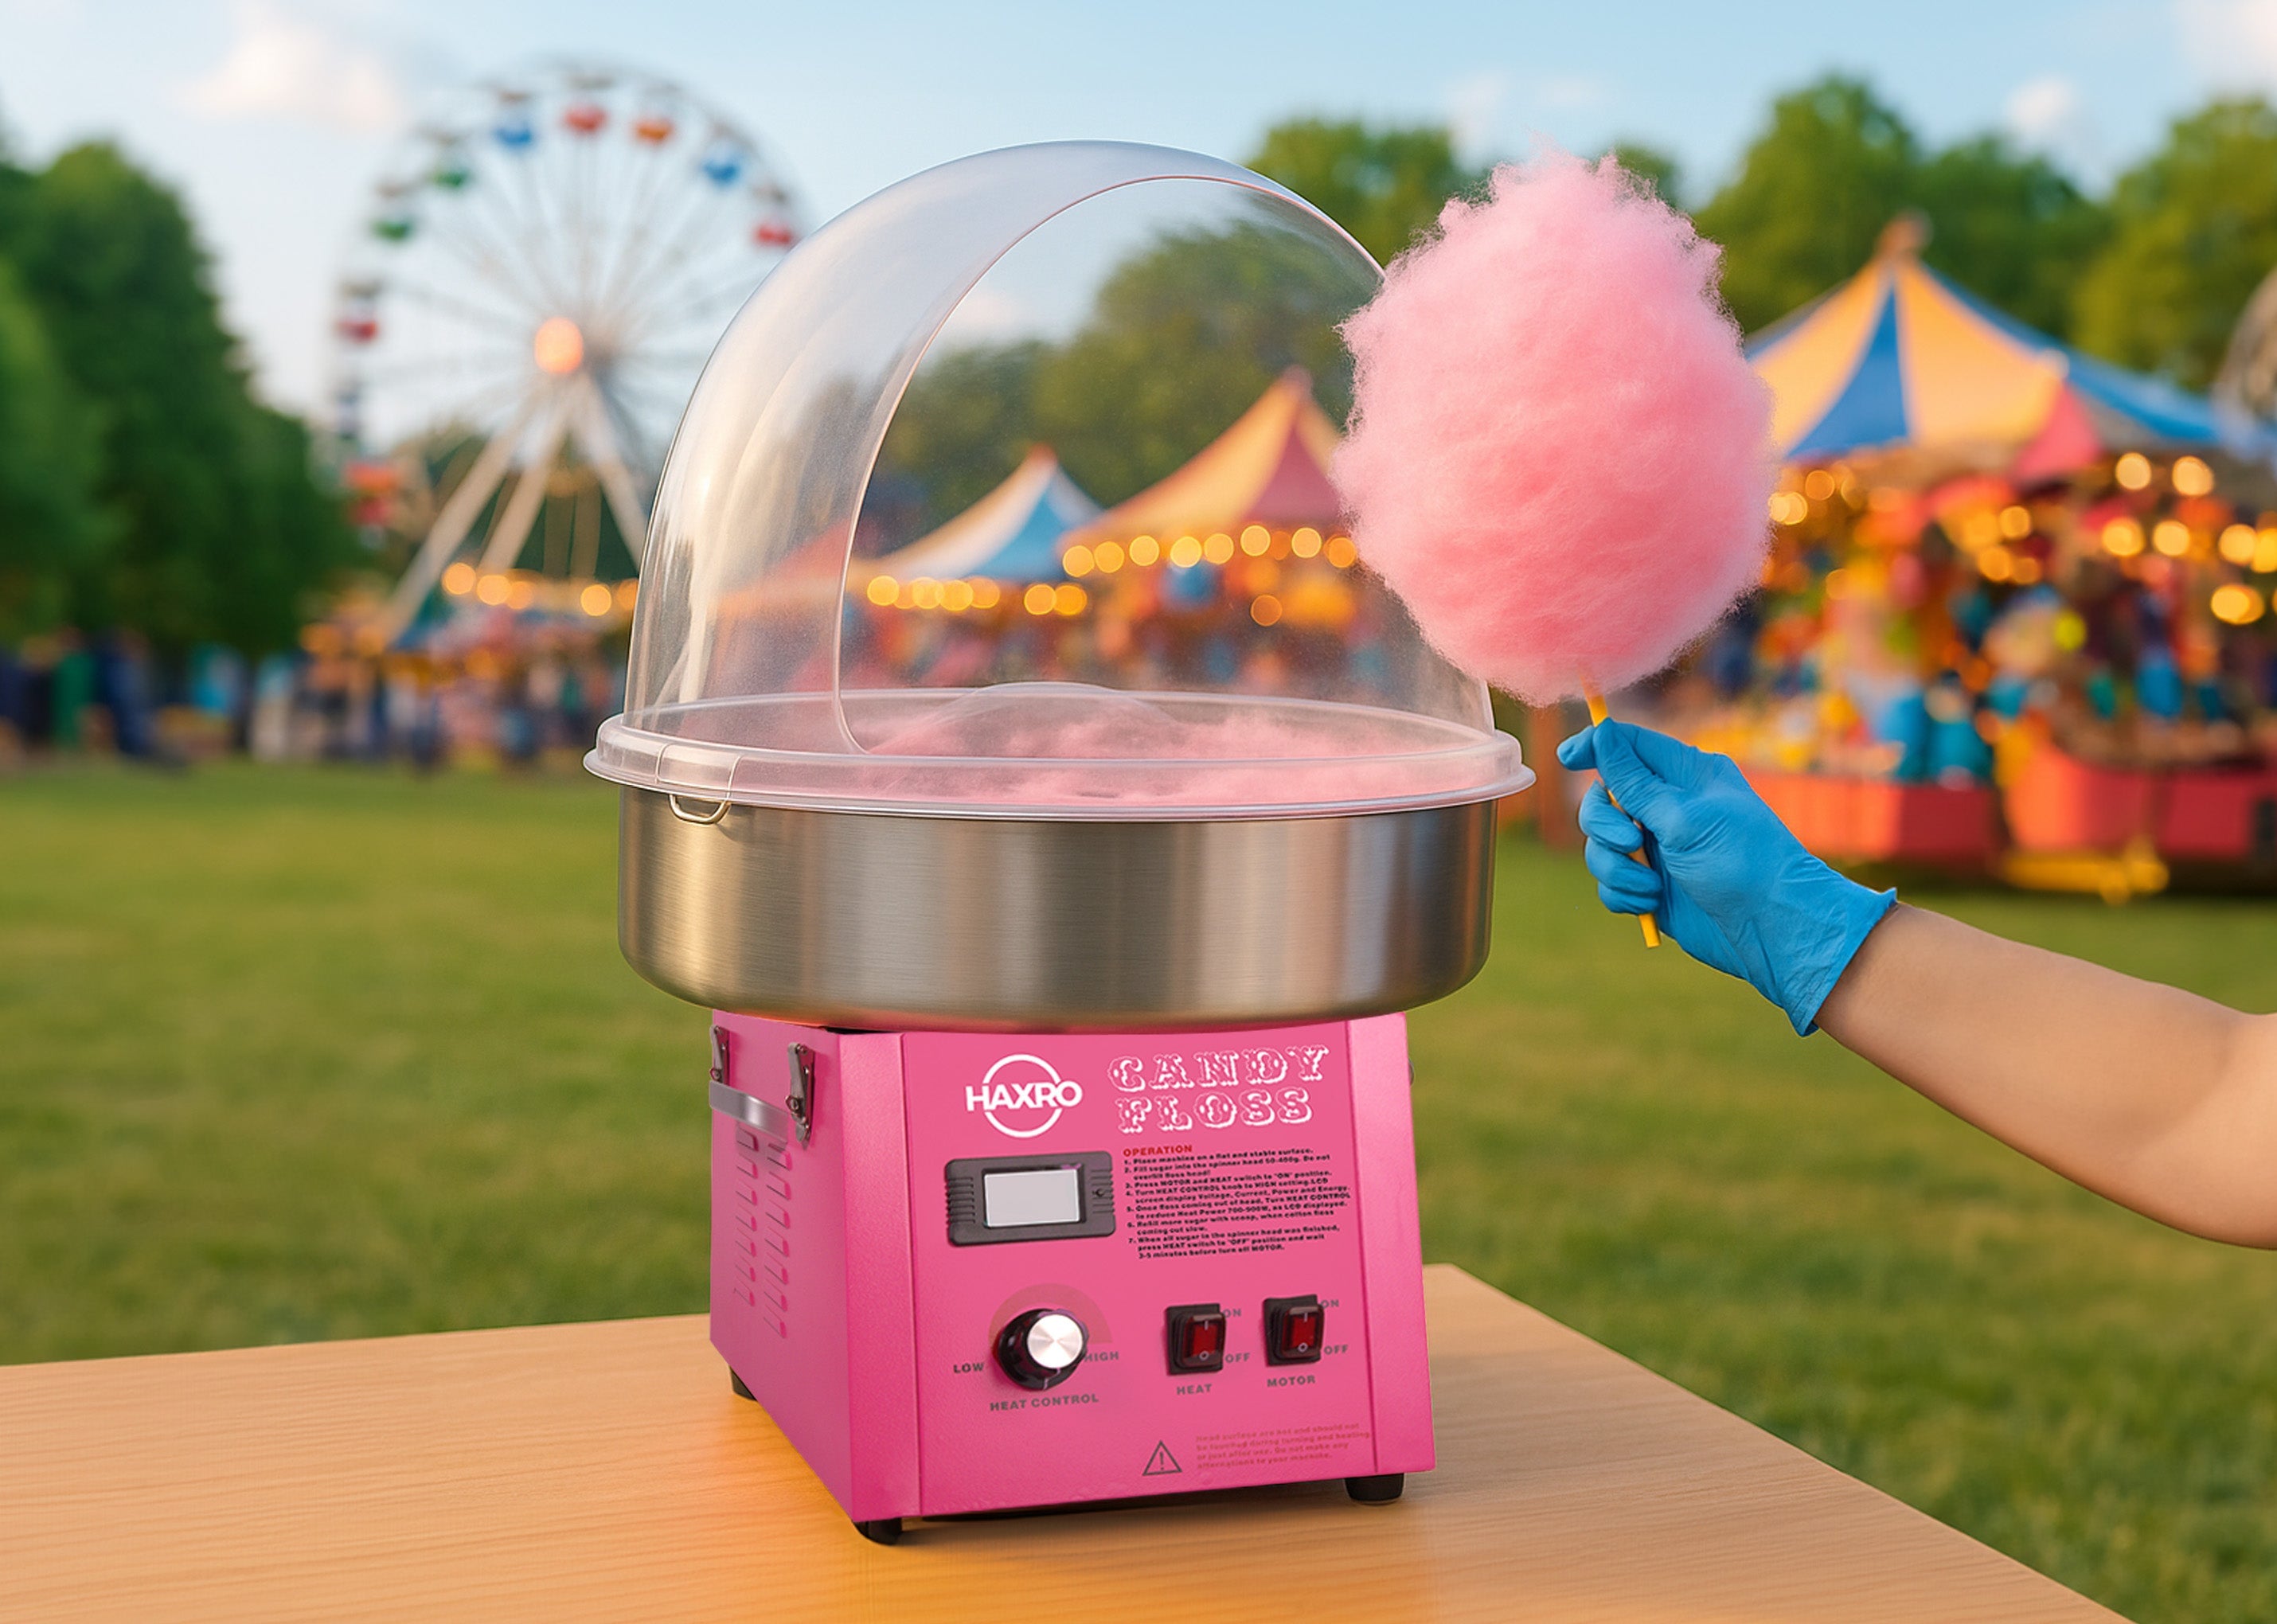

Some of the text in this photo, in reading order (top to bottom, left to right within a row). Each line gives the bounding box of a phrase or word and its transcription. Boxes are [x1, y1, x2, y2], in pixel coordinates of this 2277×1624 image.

[1107, 1044, 1330, 1092] CANDY
[966, 1080, 1083, 1112] HAXRO
[1116, 1087, 1313, 1134] FLOSS
[1123, 1145, 1193, 1157] OPERATION
[1321, 1299, 1339, 1309] ON
[1222, 1308, 1242, 1318] ON
[1324, 1345, 1349, 1355] OFF
[1084, 1351, 1119, 1362] HIGH
[1224, 1353, 1251, 1364] OFF
[953, 1363, 985, 1373] LOW
[1267, 1375, 1316, 1387] MOTOR
[1176, 1384, 1213, 1396] HEAT
[990, 1393, 1099, 1411] HEAT CONTROL
